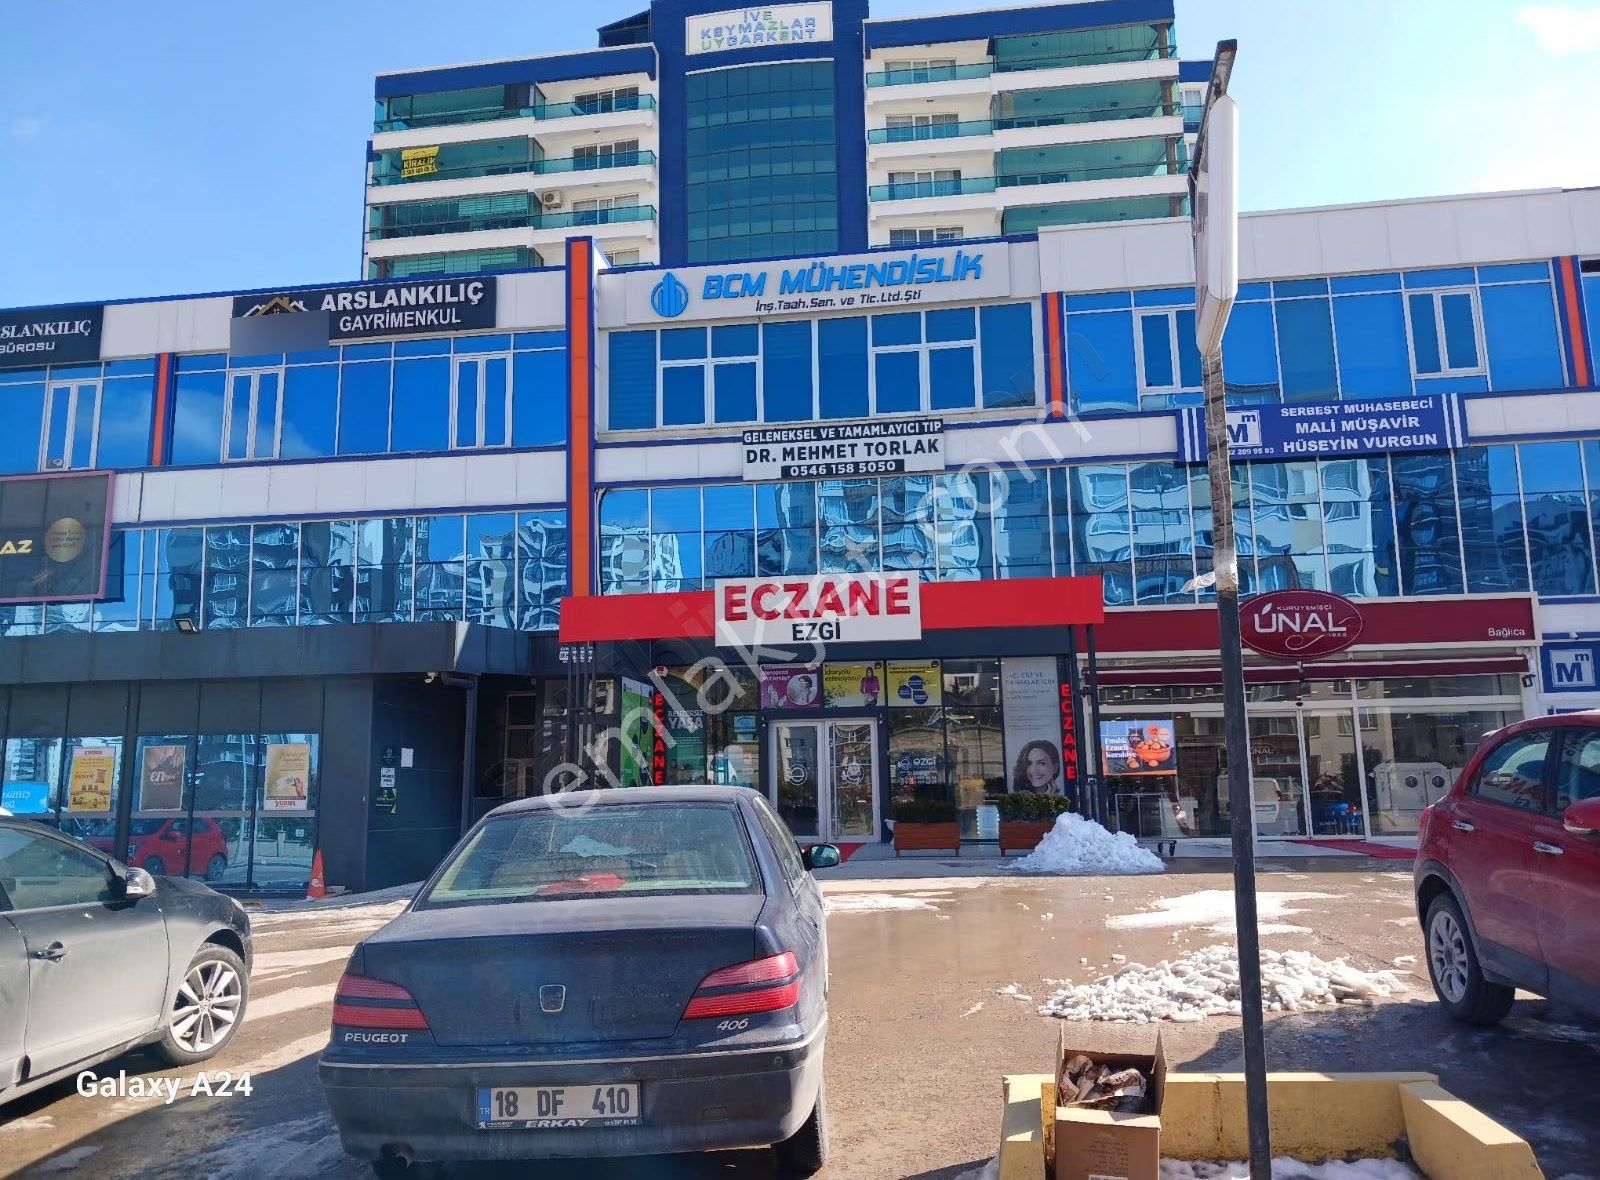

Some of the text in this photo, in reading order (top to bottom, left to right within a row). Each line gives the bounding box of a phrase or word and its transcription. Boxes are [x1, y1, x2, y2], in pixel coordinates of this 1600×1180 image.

[701, 18, 816, 39] KEYMAZLAR
[702, 28, 816, 51] UYGARKENT
[702, 250, 984, 301] BCM MÜHENDİSLİK
[321, 282, 484, 312] ARSLANKILIÇ
[0, 320, 92, 339] SLANKILIÇ
[339, 308, 461, 332] GAYRİMENKUL
[1280, 397, 1433, 417] SERBEST MUHASEBECİ
[743, 421, 942, 444] GELENEKSEL VE TAMAMLAYICI TIP
[1295, 414, 1421, 434] MALİ MÜŞAVİR
[746, 438, 939, 464] DR. MEHMET TORLAK
[1283, 433, 1438, 453] HÜSEYİN VURGUN
[789, 461, 896, 477] 0546 158 5050
[724, 578, 911, 622] ECZANE
[792, 618, 842, 642] EZGİ
[1061, 683, 1076, 780] ECZANE
[716, 1018, 750, 1031] 406
[344, 1032, 409, 1044] PEUGEOT
[495, 1087, 631, 1118] 18 DF 410
[525, 1119, 590, 1128] ERKAY
